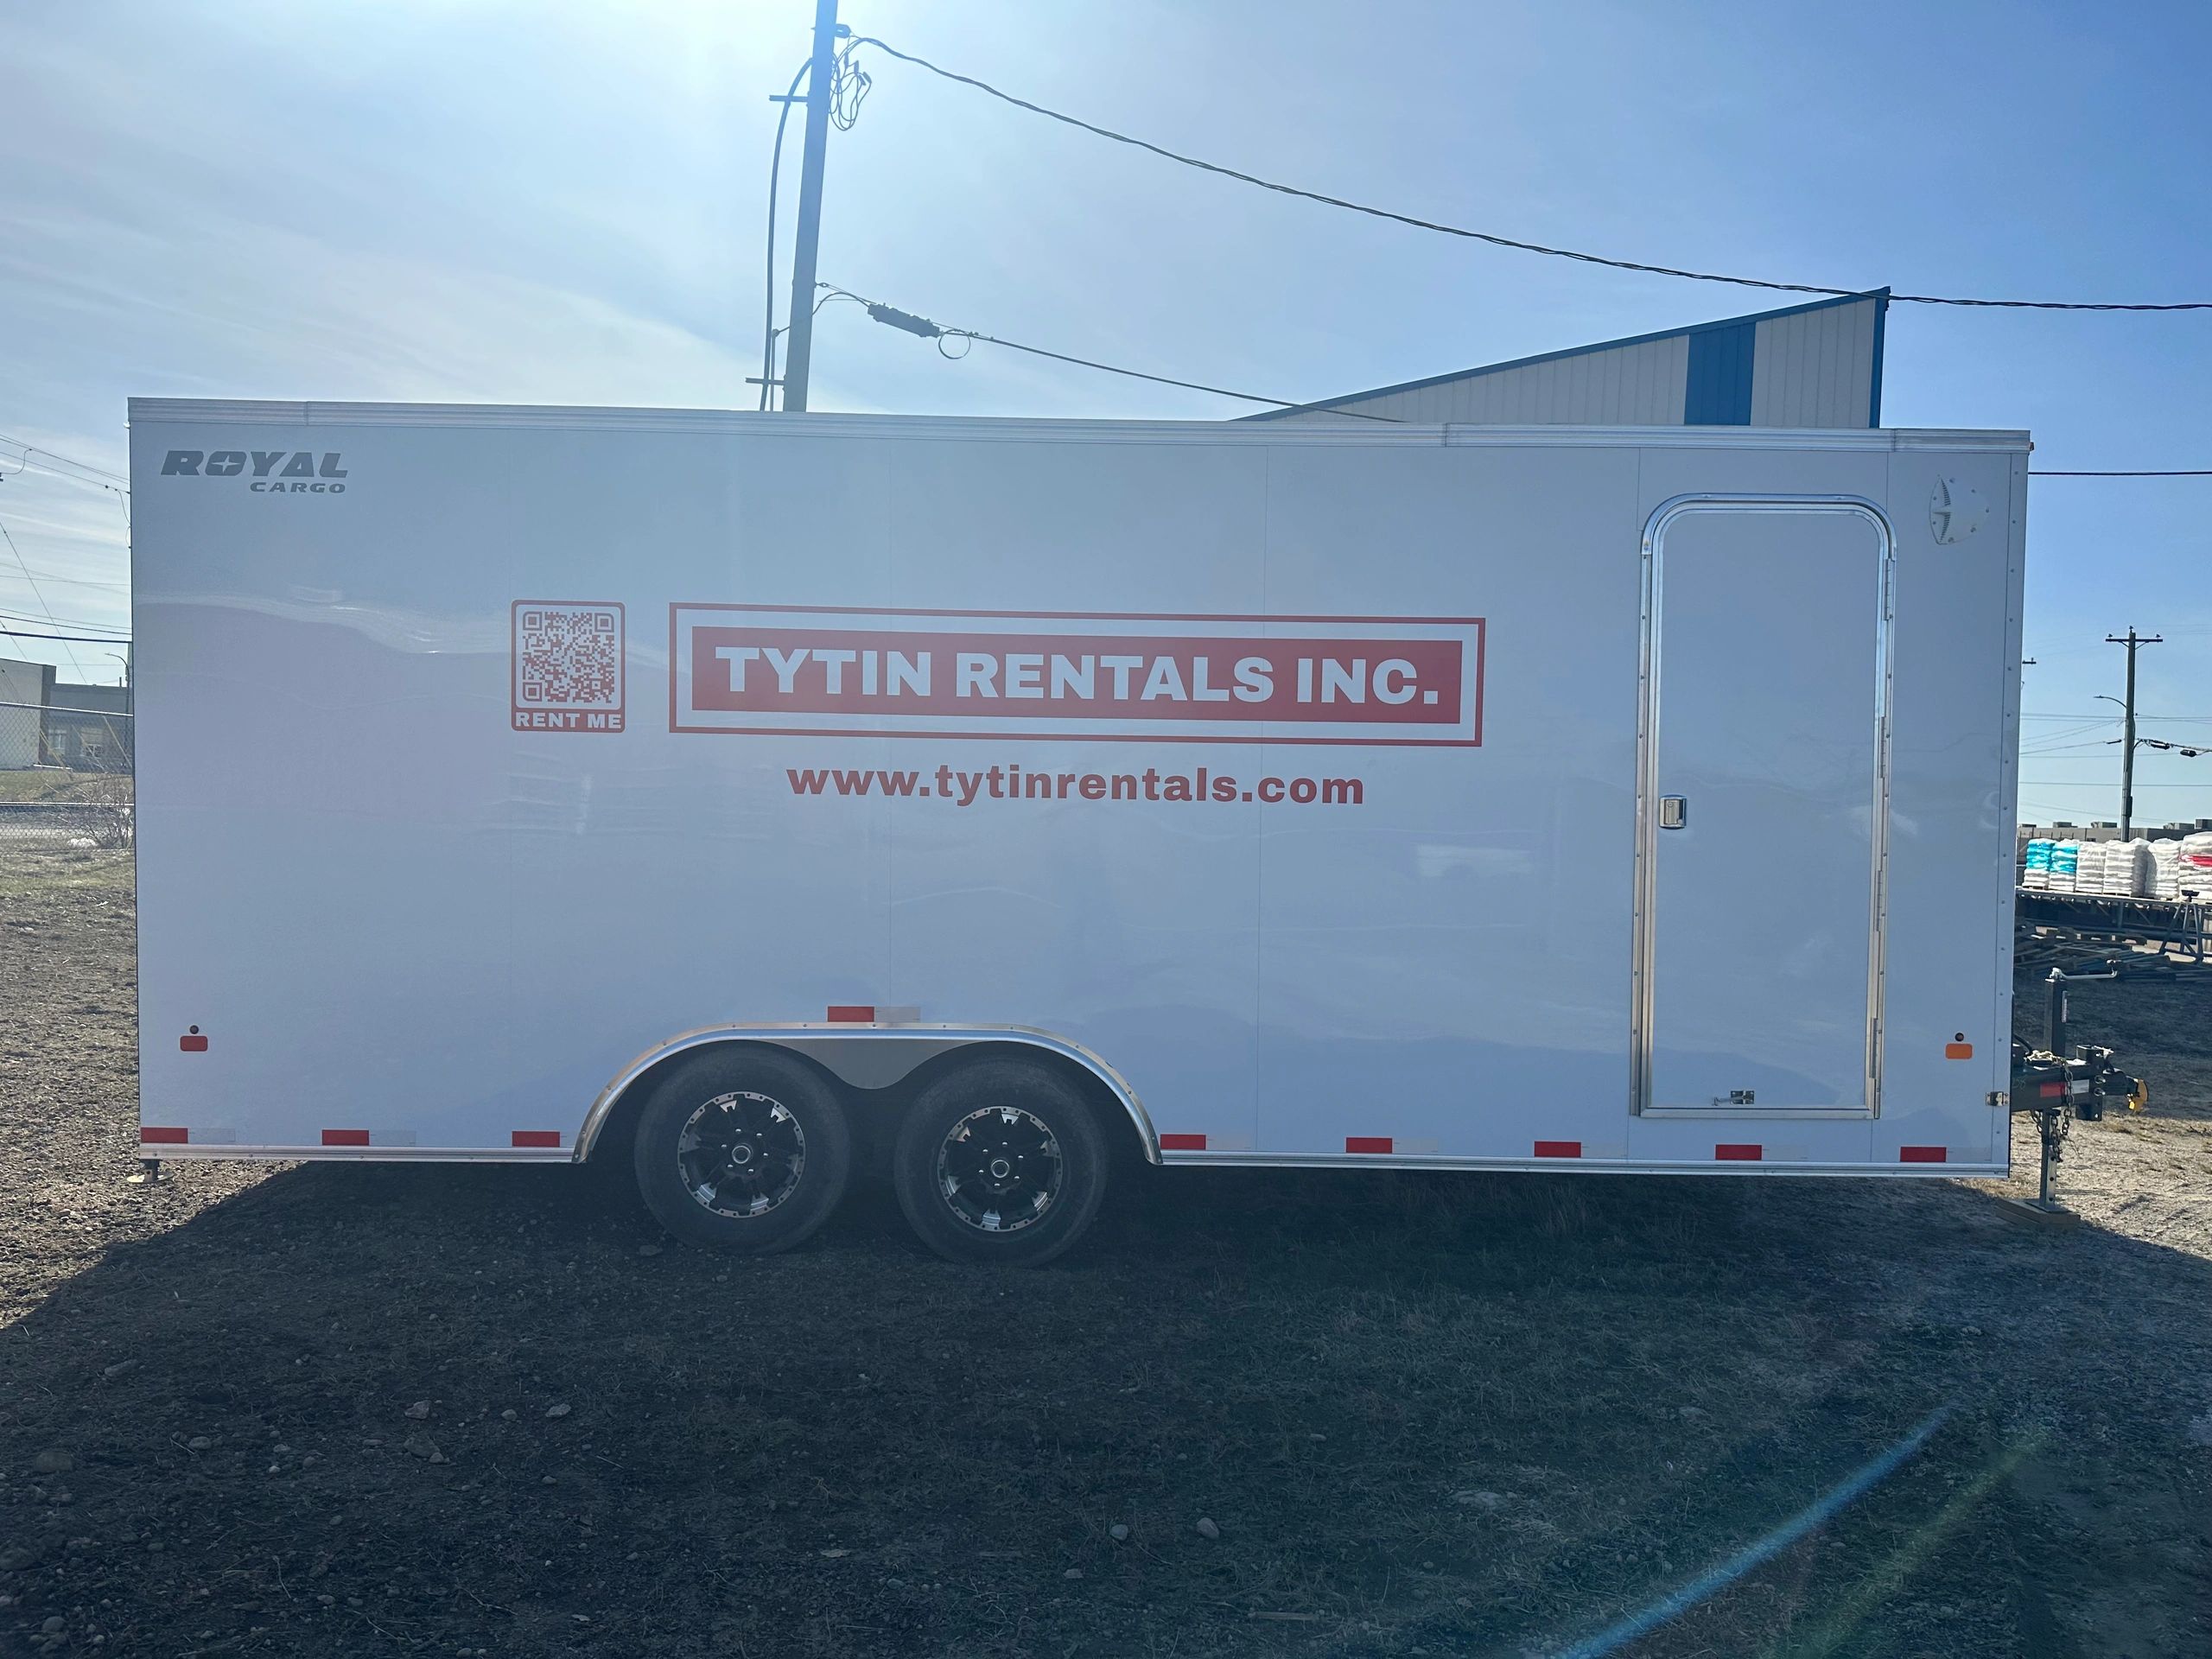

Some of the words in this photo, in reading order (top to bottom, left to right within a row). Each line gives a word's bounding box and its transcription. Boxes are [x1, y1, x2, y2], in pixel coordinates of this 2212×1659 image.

[161, 449, 348, 478] ROYAL
[250, 481, 346, 493] CARGO
[715, 645, 931, 697] TYTIN
[956, 652, 1274, 703] RENTALS
[1296, 658, 1439, 705] INC.
[515, 711, 580, 728] RENT
[587, 713, 622, 729] ME
[785, 764, 1364, 807] www.tytinrentals.com
